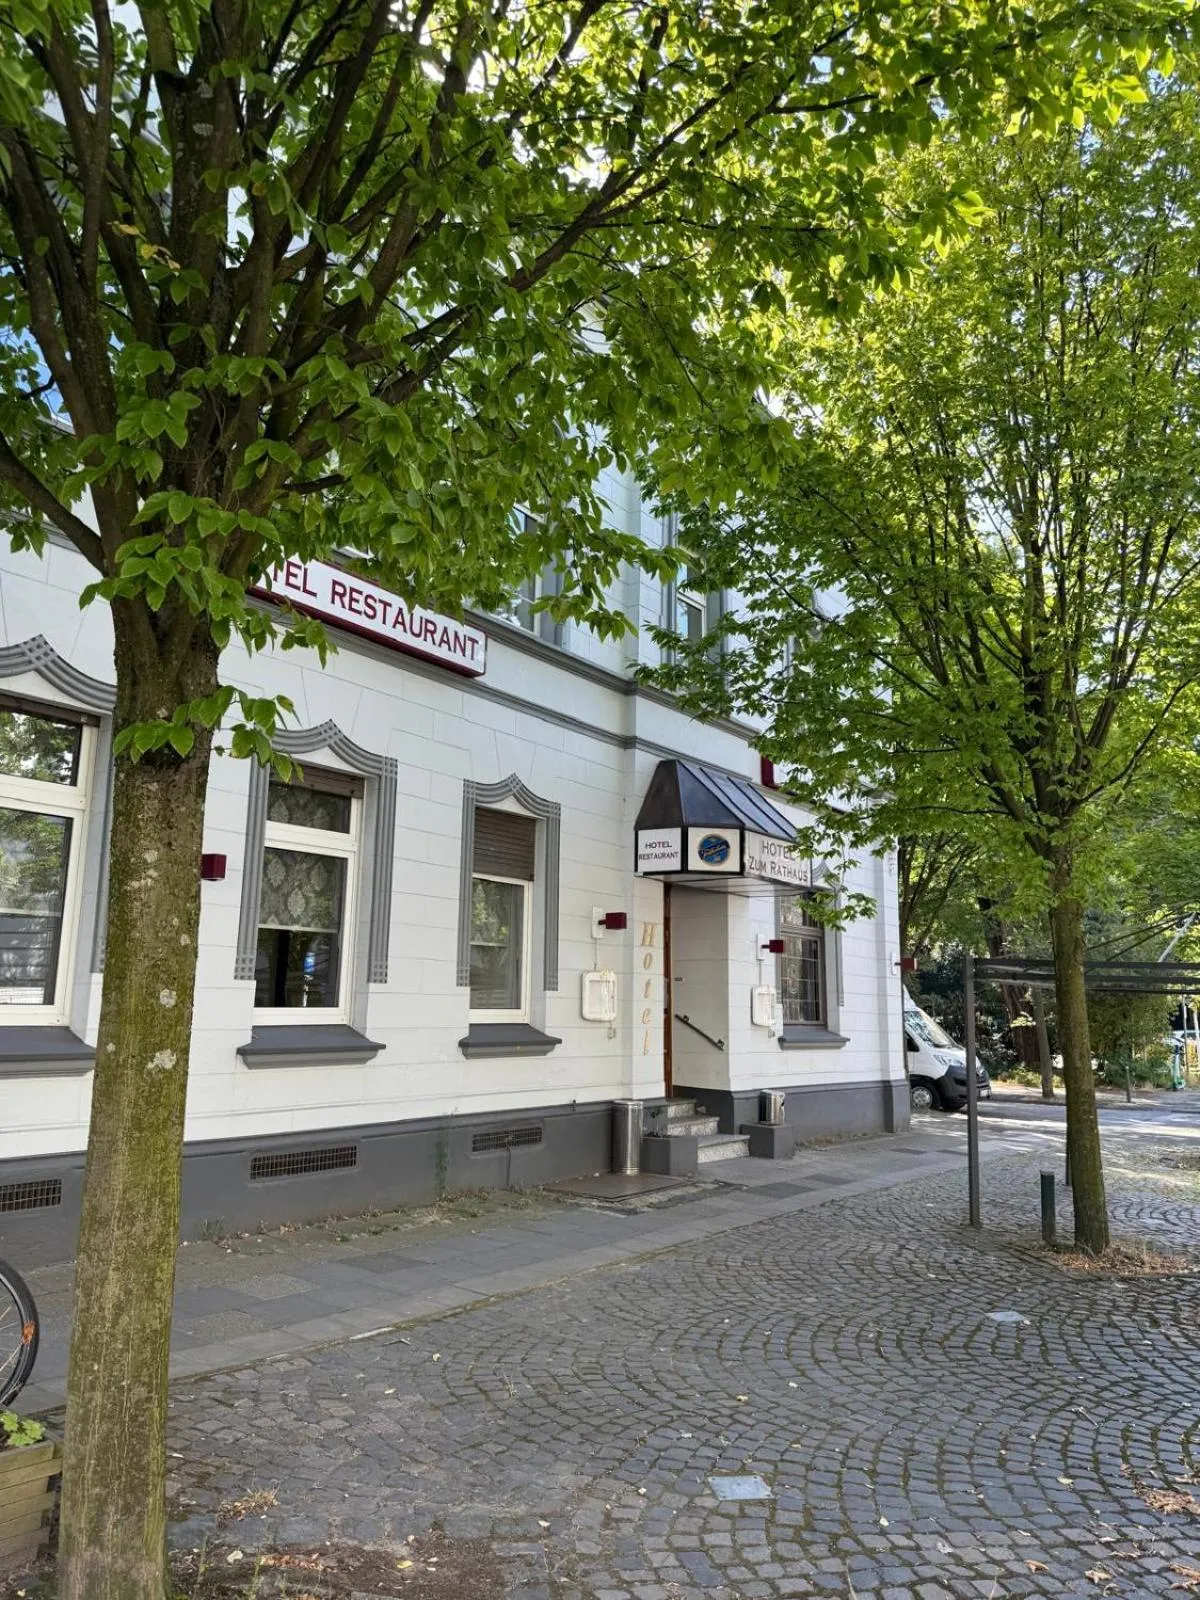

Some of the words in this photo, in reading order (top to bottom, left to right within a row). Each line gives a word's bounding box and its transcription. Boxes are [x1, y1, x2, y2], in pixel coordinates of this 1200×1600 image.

[331, 579, 479, 661] RESTAURANT
[639, 852, 679, 860] RESTAURANT
[645, 841, 672, 849] HOTEL
[749, 855, 767, 873] ZUM
[770, 860, 808, 882] RATHAUS
[641, 922, 656, 1057] Hotel
